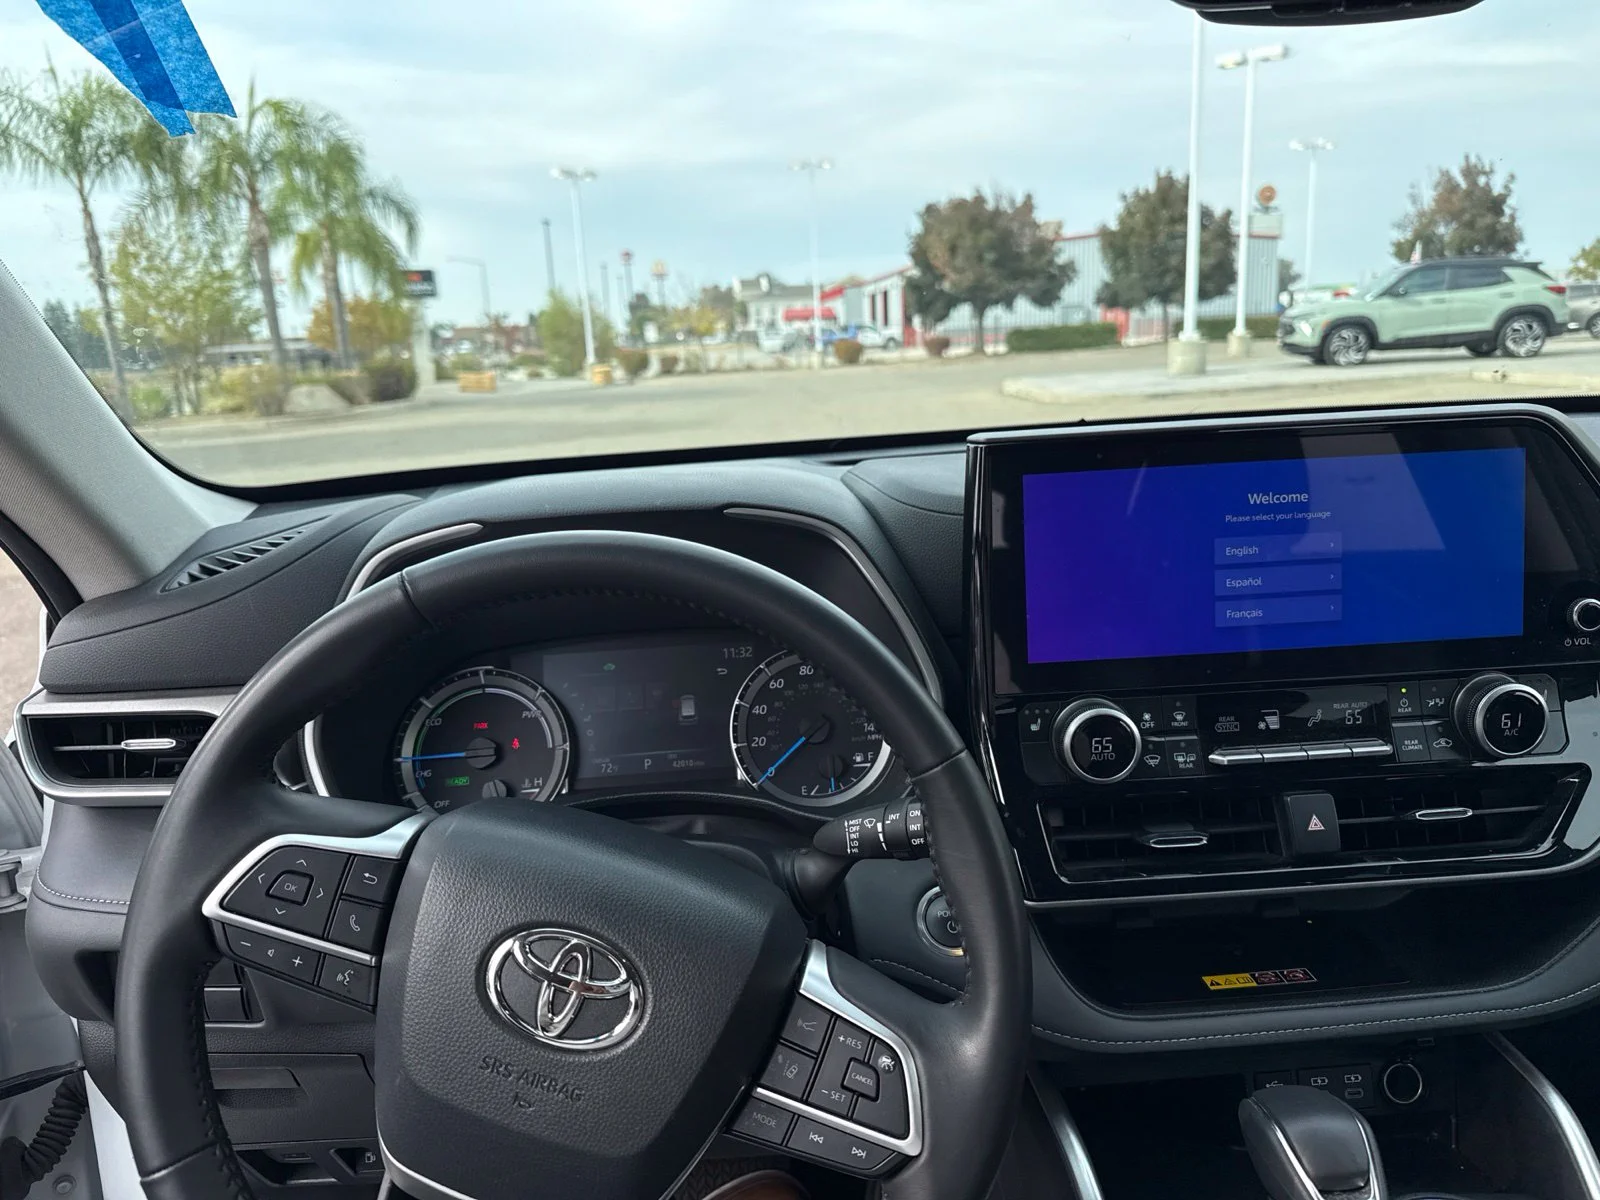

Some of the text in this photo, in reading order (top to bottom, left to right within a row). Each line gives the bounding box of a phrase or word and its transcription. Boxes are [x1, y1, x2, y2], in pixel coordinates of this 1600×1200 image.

[1248, 491, 1309, 505] Welcome
[1225, 510, 1331, 523] Please select your language
[1225, 545, 1259, 558] English
[1226, 576, 1262, 589] Español
[1226, 608, 1263, 620] Français
[1574, 637, 1591, 646] VOL
[723, 647, 753, 660] 11:32
[799, 665, 814, 676] 80
[769, 678, 784, 689] 60
[522, 710, 542, 719] PWR
[752, 704, 767, 715] 40
[1345, 709, 1362, 725] 65
[1501, 713, 1522, 729] 61
[425, 718, 442, 727] ECO
[863, 722, 877, 732] 14
[1140, 720, 1155, 729] OFF
[1216, 723, 1239, 732] SYNC
[1504, 728, 1519, 737] A/C
[751, 736, 767, 747] 20
[1091, 737, 1113, 753] 65
[867, 752, 874, 761] F
[1090, 752, 1115, 761] AUTO
[644, 758, 652, 770] P
[415, 769, 432, 778] CHG
[534, 777, 542, 786] H
[801, 785, 808, 795] E
[434, 799, 450, 808] OFF
[849, 818, 862, 826] MIST
[909, 823, 921, 831] INT
[849, 825, 860, 833] OFF
[849, 832, 860, 840] INT
[911, 837, 925, 845] OFF
[284, 882, 298, 893] OK
[480, 1055, 582, 1103] SRS AIRBAG
[851, 1071, 874, 1086] CANCEL
[752, 1110, 778, 1129] MODE
